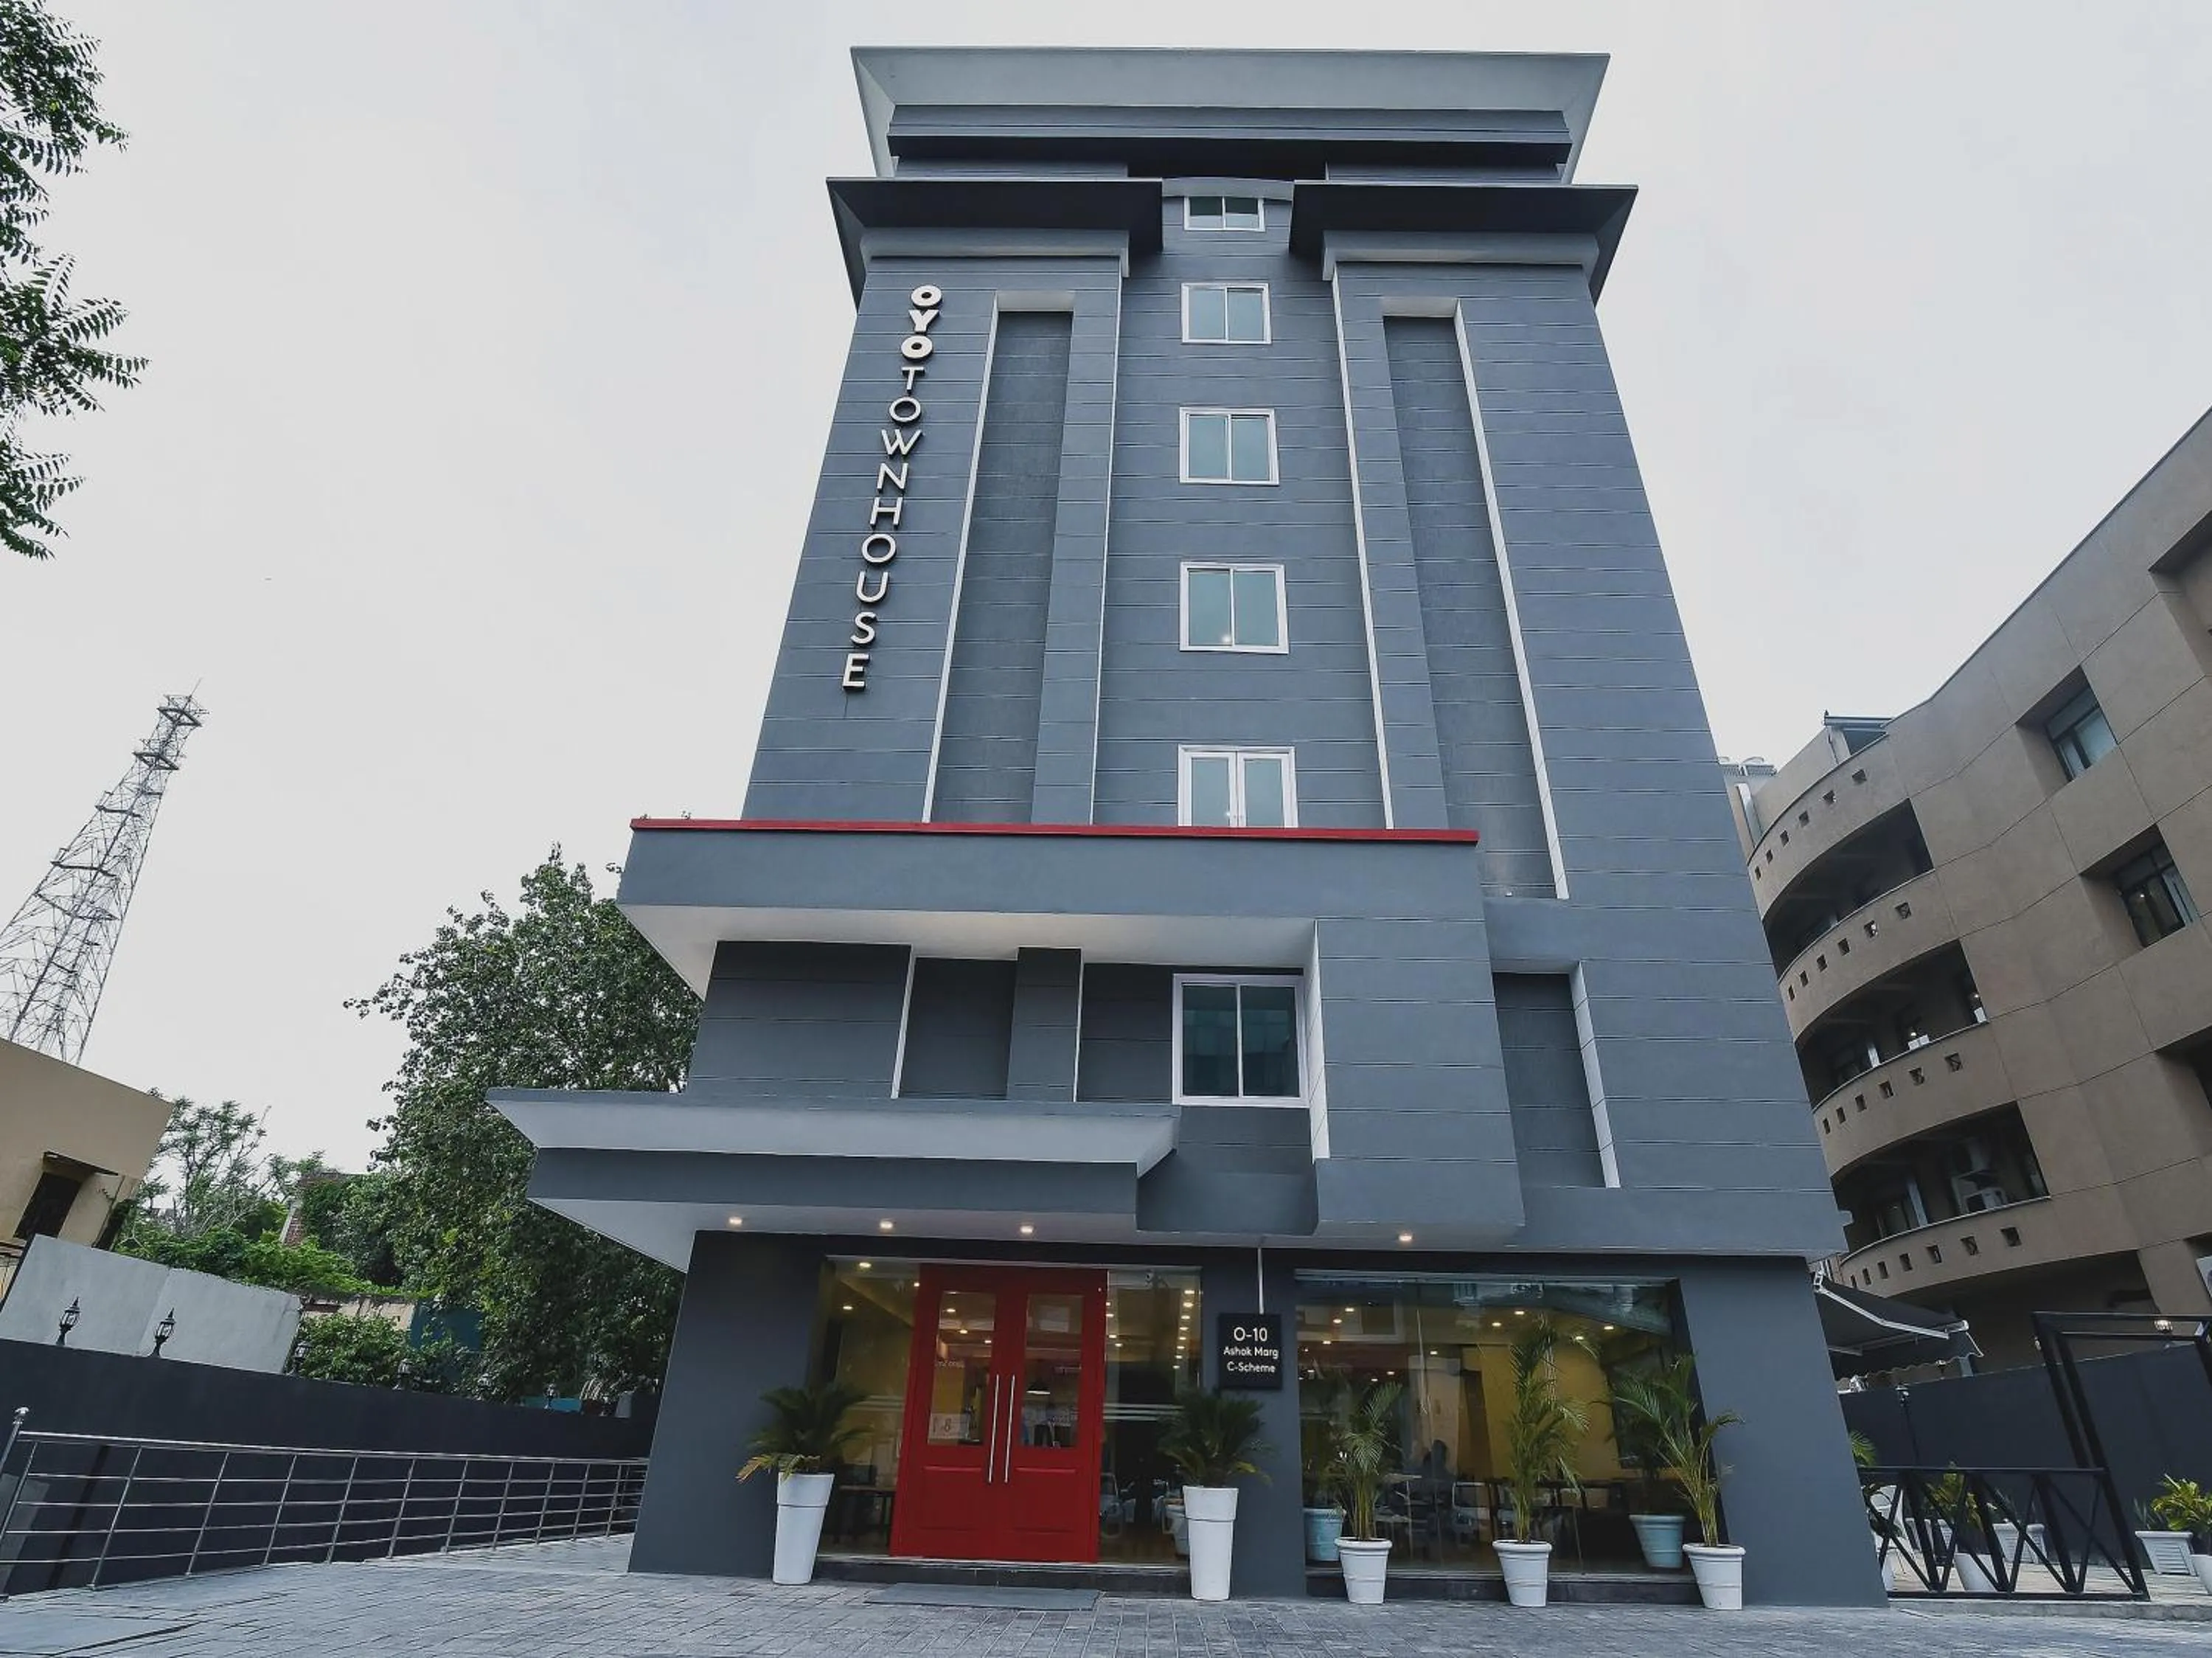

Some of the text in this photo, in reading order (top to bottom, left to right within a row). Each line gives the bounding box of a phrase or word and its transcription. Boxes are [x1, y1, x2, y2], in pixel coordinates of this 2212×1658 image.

[841, 285, 942, 689] OYO TOWNHOUSE
[1223, 1346, 1279, 1359] Ashok Marg
[1226, 1361, 1276, 1373] C-Scheme
